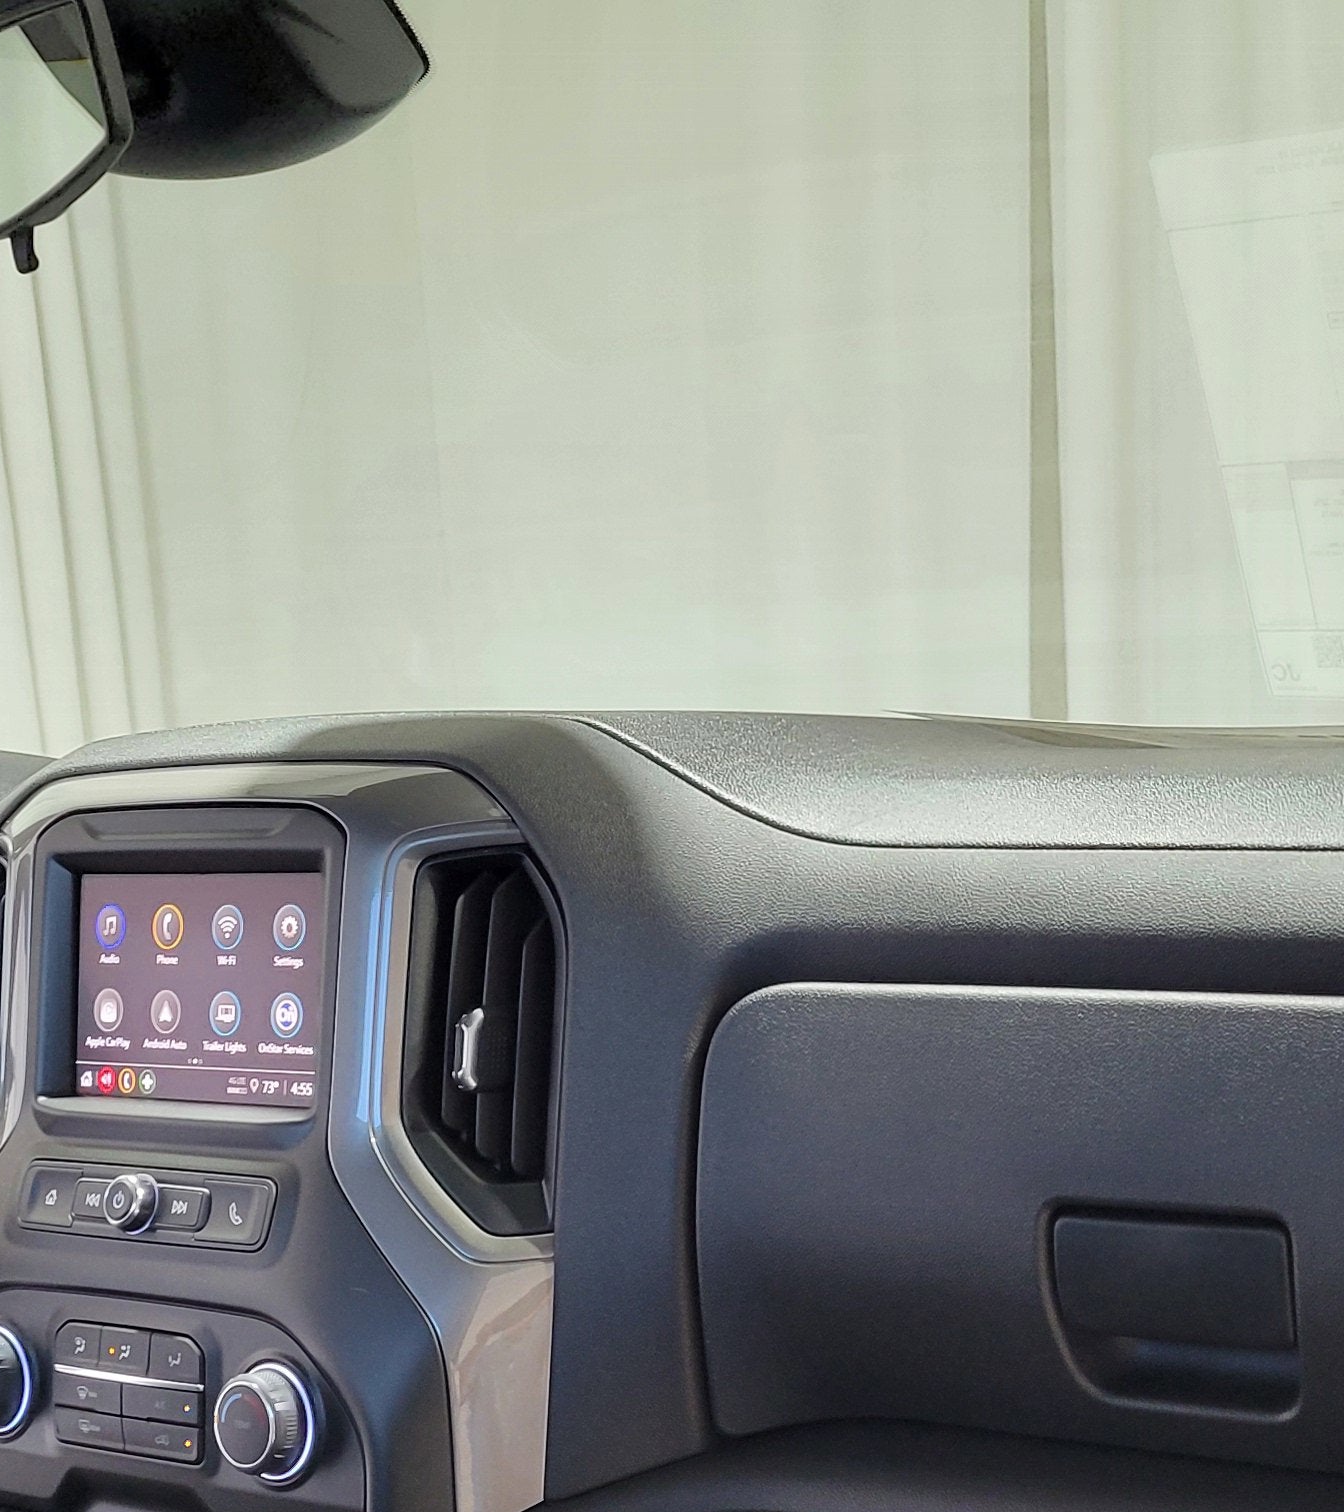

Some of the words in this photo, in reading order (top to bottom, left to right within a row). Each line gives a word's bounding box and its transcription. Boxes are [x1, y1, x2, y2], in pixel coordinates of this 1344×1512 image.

[99, 954, 120, 964] Audio
[156, 954, 179, 965] Phone
[217, 955, 237, 966] Wi-Fi
[273, 956, 304, 969] Settings
[85, 1036, 105, 1049] Apple
[105, 1037, 131, 1050] CarPlay
[142, 1038, 170, 1049] Android
[170, 1040, 188, 1050] Auto
[202, 1040, 224, 1051] Trailer
[224, 1041, 247, 1055] Lights
[283, 1044, 314, 1055] Services
